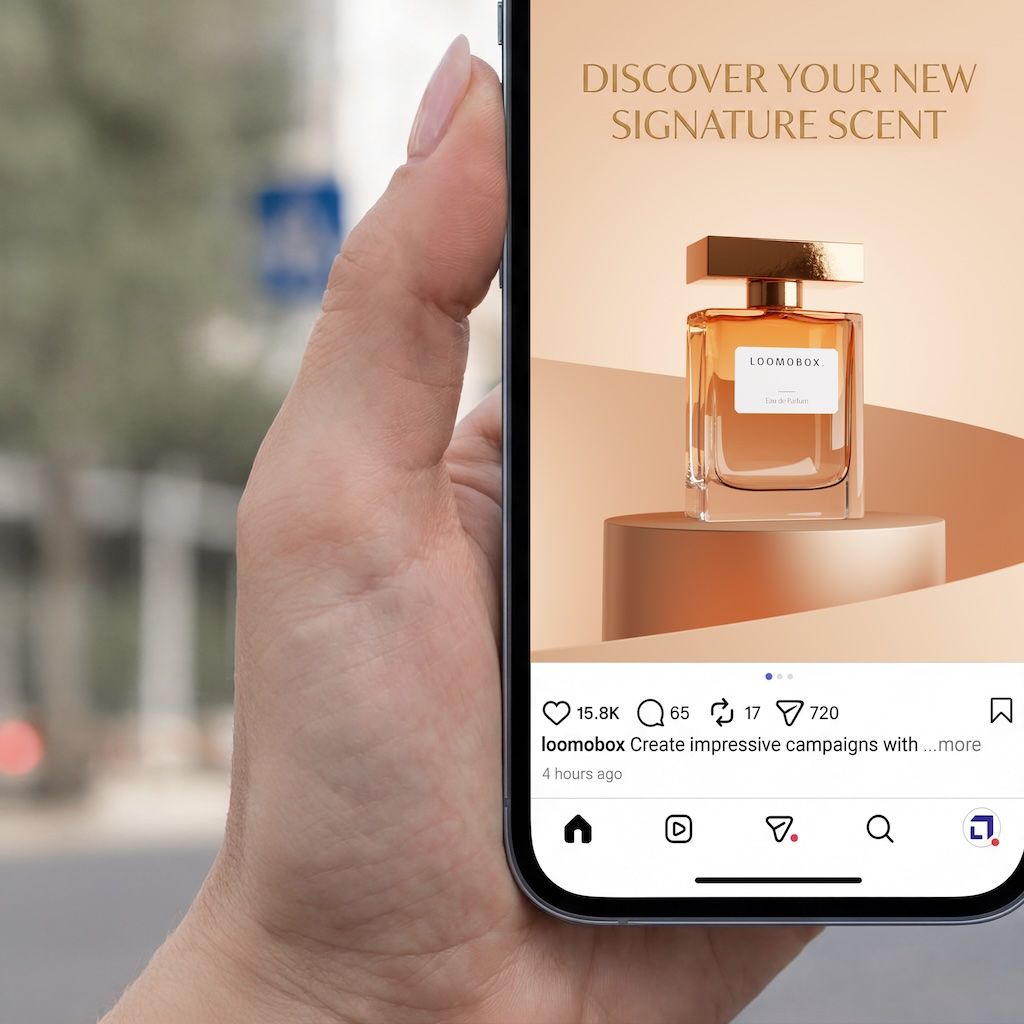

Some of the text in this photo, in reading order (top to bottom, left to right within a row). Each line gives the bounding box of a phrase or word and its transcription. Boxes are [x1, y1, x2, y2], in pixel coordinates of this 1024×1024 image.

[582, 63, 978, 94] DISCOVER YOUR NEW
[611, 108, 948, 140] SIGNATURE SCENT
[765, 397, 777, 405] Eau
[777, 397, 787, 405] de
[576, 705, 839, 721] 15.8K 65 17 720
[541, 735, 625, 753] loomobox
[630, 736, 685, 753] Create
[690, 736, 781, 756] impressive
[785, 737, 878, 756] campaigns
[882, 736, 919, 753] with
[542, 767, 623, 783] 4 hours ago
